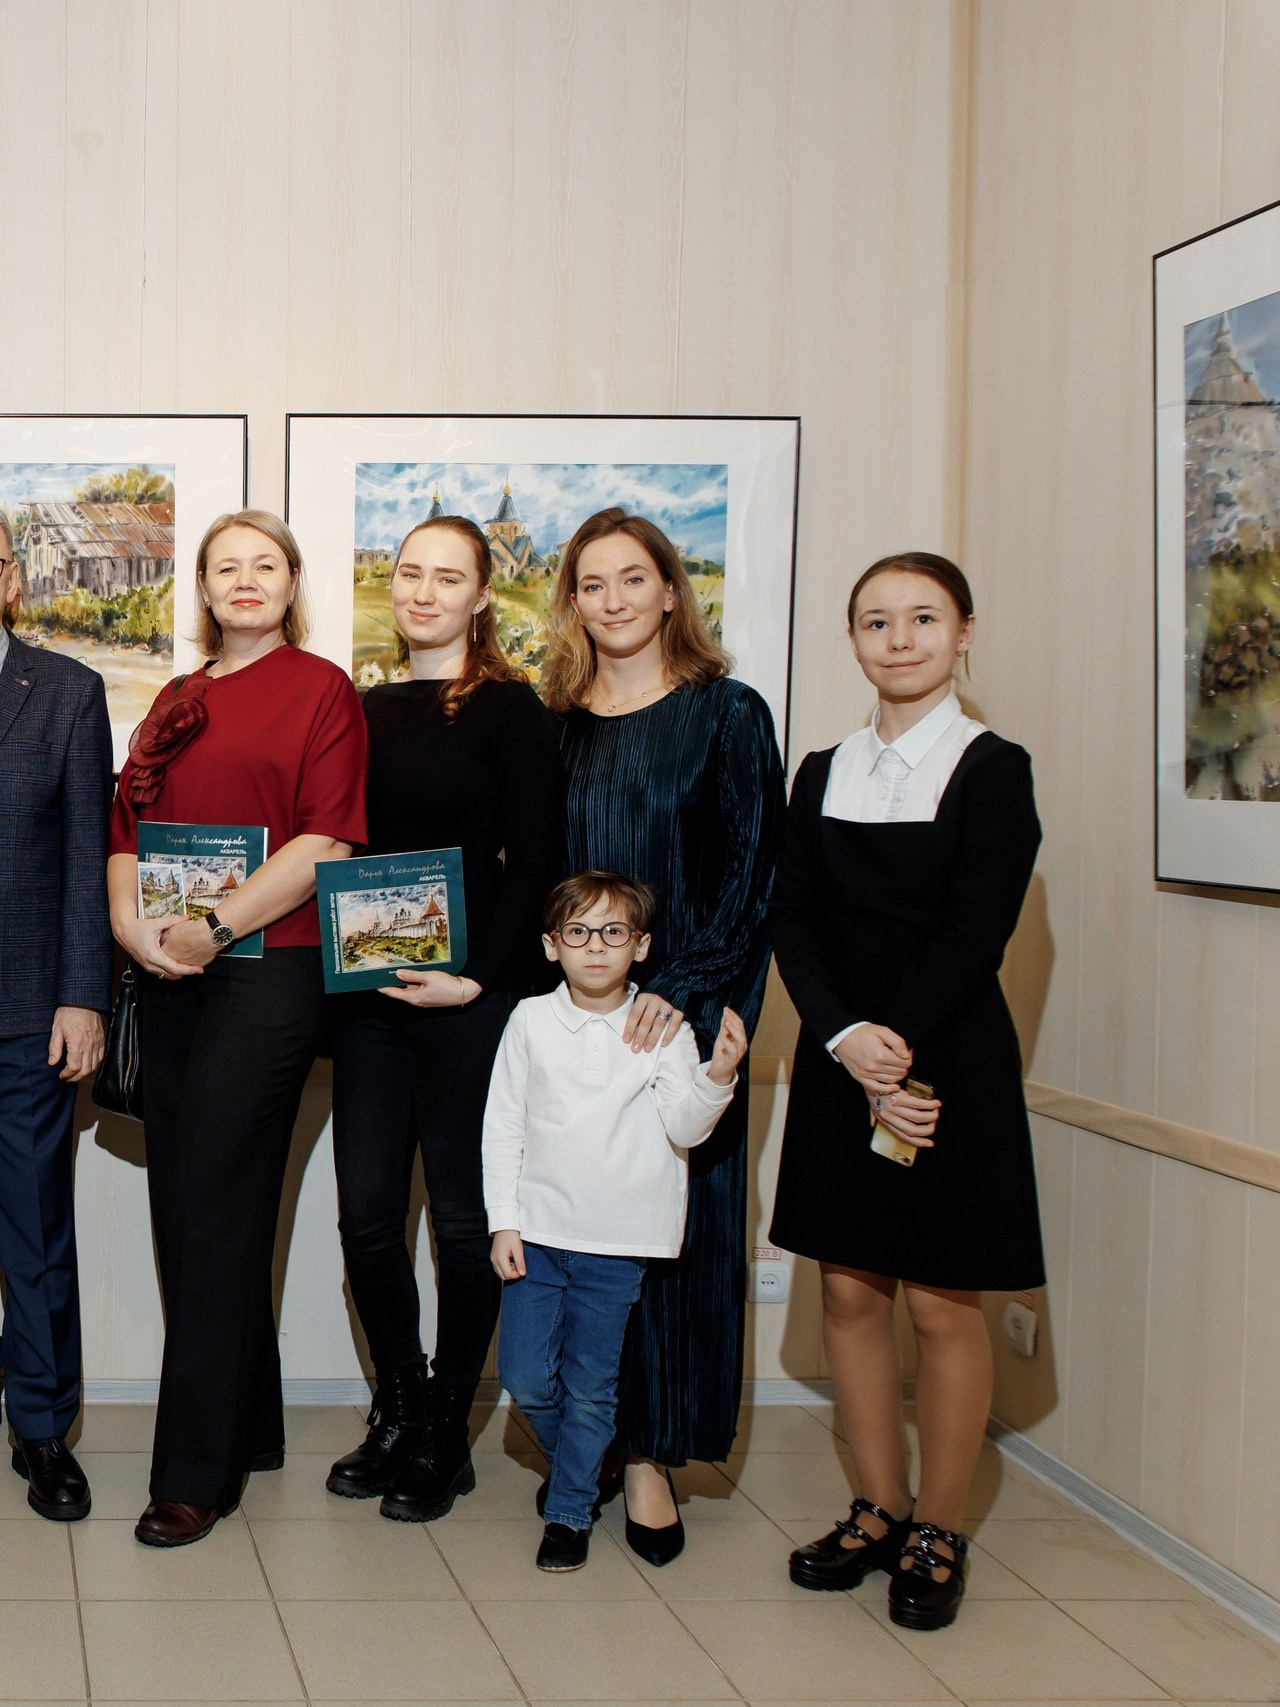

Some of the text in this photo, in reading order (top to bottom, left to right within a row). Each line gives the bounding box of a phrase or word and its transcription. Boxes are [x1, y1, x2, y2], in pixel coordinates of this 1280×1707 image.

[191, 834, 247, 848] Александрова
[388, 860, 446, 876] Александрова
[418, 873, 447, 882] АКВАРЕЛЬ
